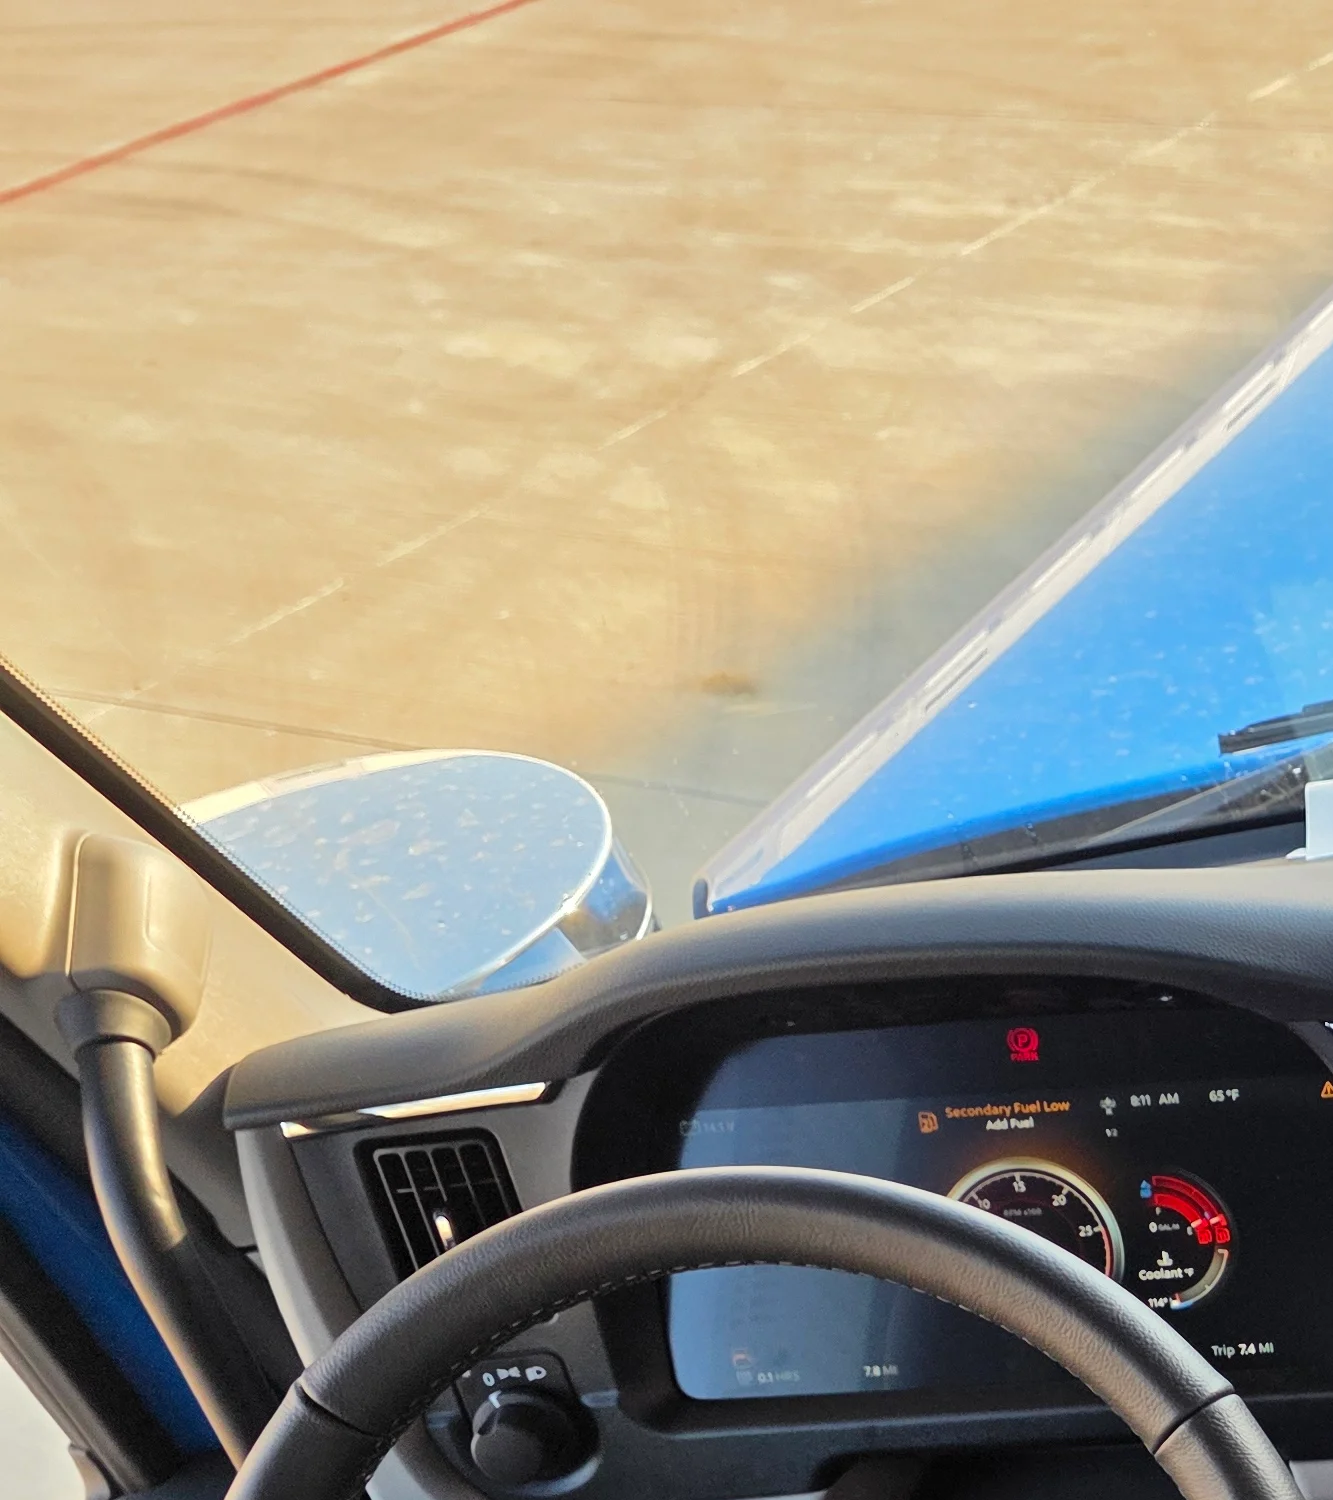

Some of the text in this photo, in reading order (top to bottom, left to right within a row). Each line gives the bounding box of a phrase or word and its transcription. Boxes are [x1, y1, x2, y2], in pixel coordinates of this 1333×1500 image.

[1010, 1052, 1039, 1062] PARK
[1158, 1092, 1180, 1105] AM
[945, 1100, 1071, 1119] Secondary Fuel Low
[985, 1116, 1034, 1130] Add Fuel
[1012, 1180, 1027, 1194] 15
[1051, 1194, 1067, 1207] 20
[1078, 1224, 1094, 1238] 25
[1138, 1267, 1183, 1281] Coolant
[1211, 1342, 1275, 1358] Trip 7.4 MI
